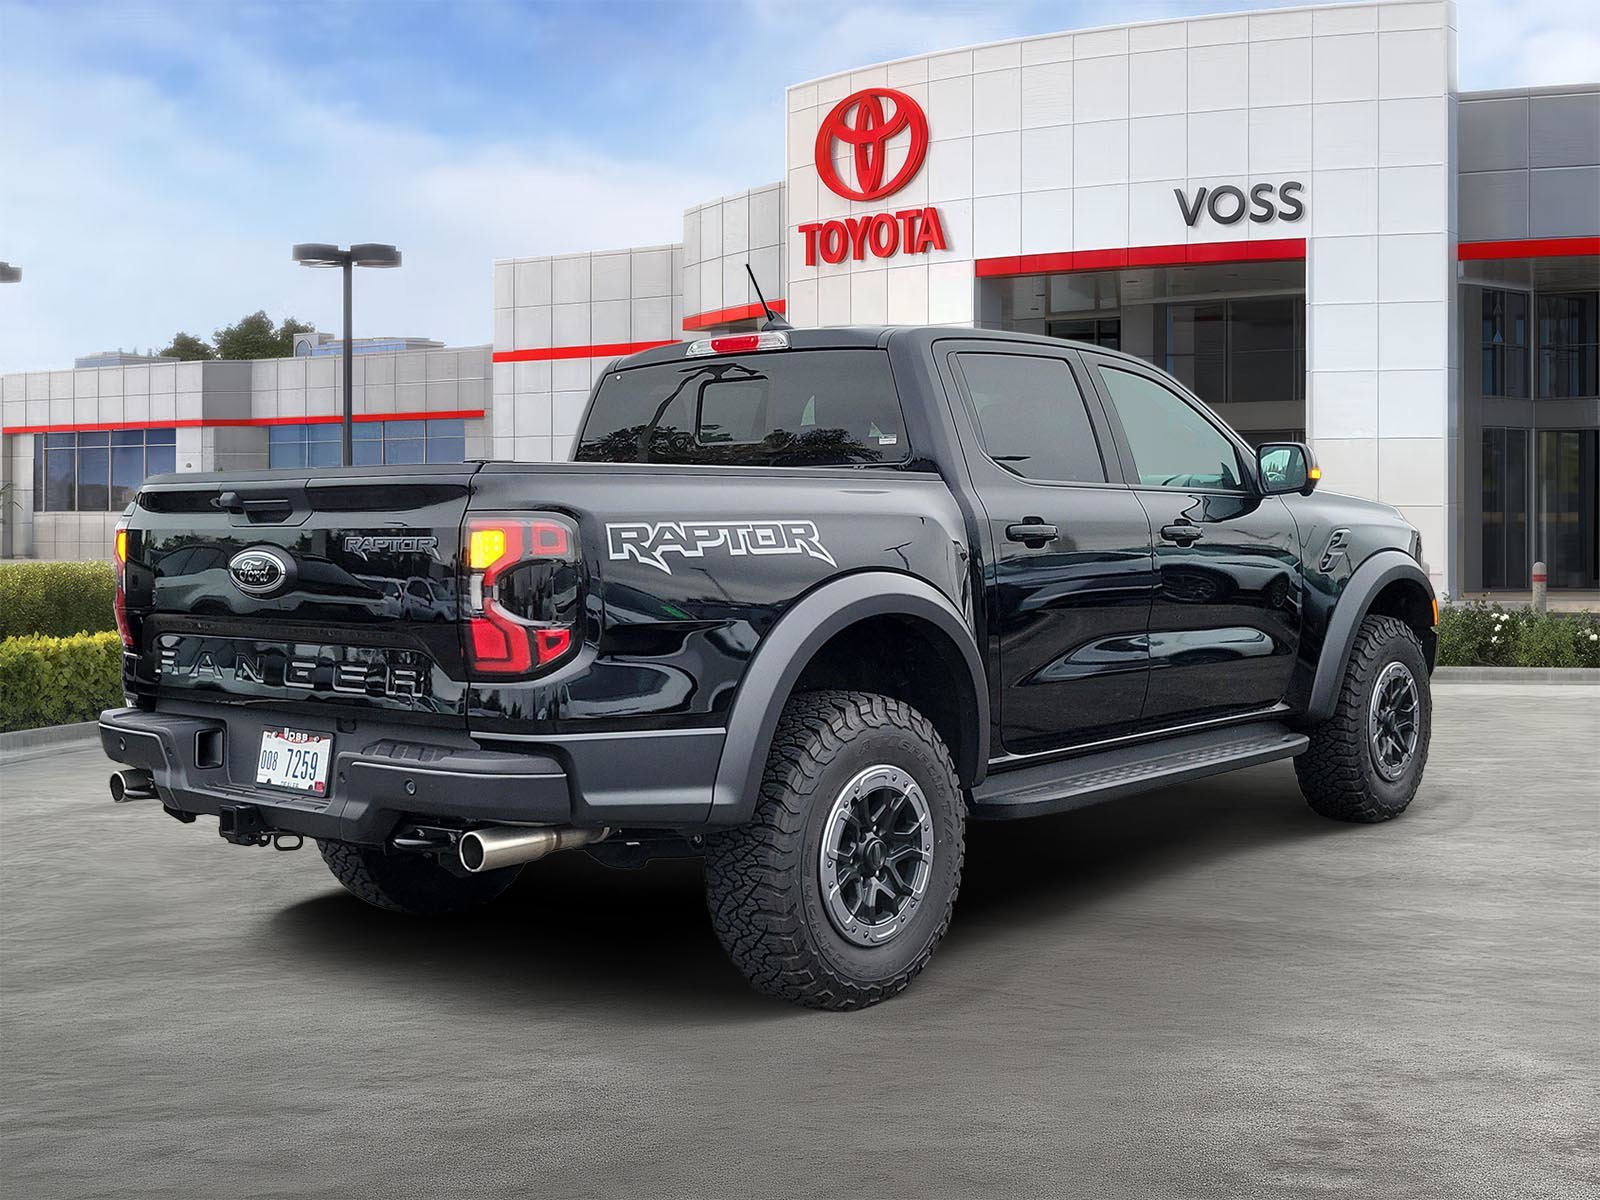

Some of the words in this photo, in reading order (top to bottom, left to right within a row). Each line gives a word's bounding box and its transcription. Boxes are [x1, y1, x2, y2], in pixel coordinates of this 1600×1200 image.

[1173, 181, 1304, 227] VOSS
[798, 206, 947, 267] TOYOTA
[344, 536, 441, 562] RAPTOR
[605, 519, 839, 576] RAPTOR
[238, 559, 270, 583] Ford
[260, 749, 279, 771] 008
[285, 748, 319, 781] 7259
